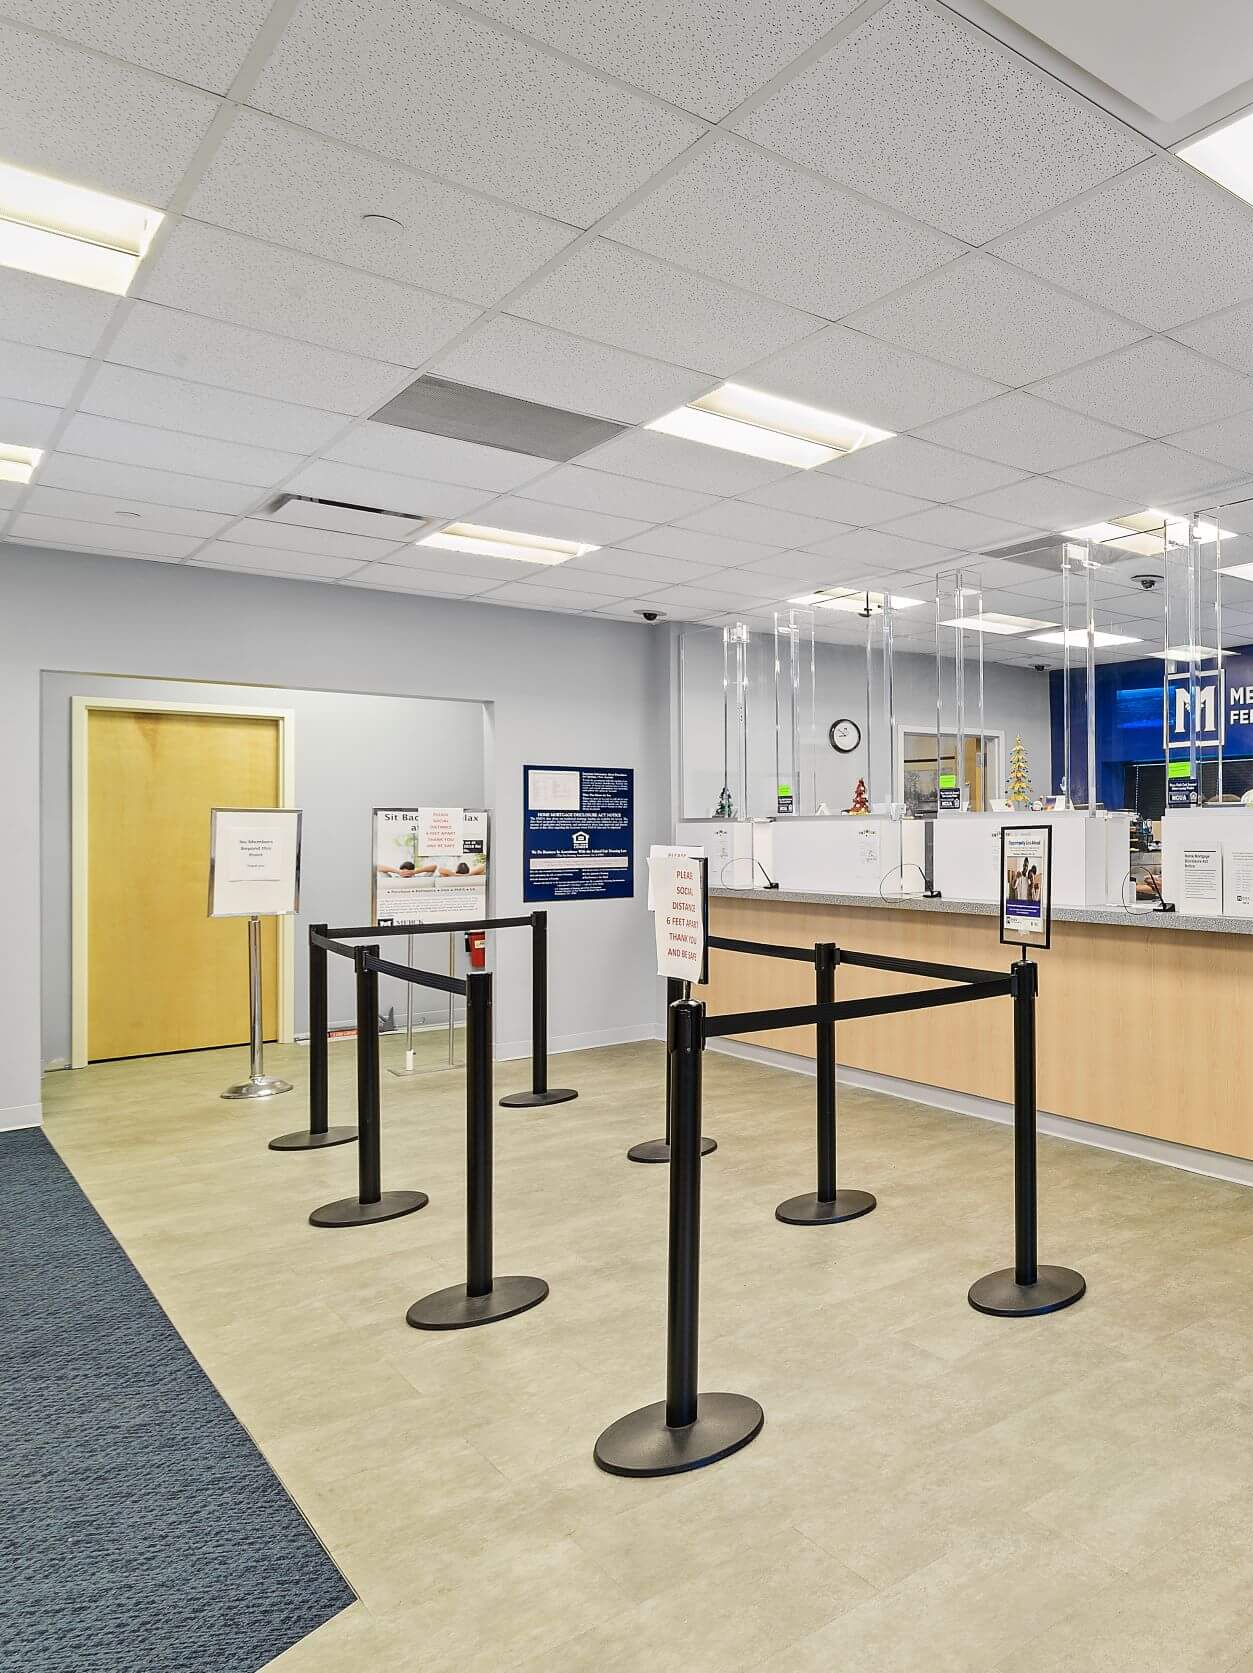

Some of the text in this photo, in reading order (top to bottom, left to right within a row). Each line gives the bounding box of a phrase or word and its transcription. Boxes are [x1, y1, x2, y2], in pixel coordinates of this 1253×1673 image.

[384, 813, 398, 821] Sit
[402, 813, 419, 821] Bac
[666, 916, 699, 929] 6 FEET APART
[668, 932, 688, 943] THANK
[667, 947, 681, 957] AND
[681, 950, 688, 959] BE
